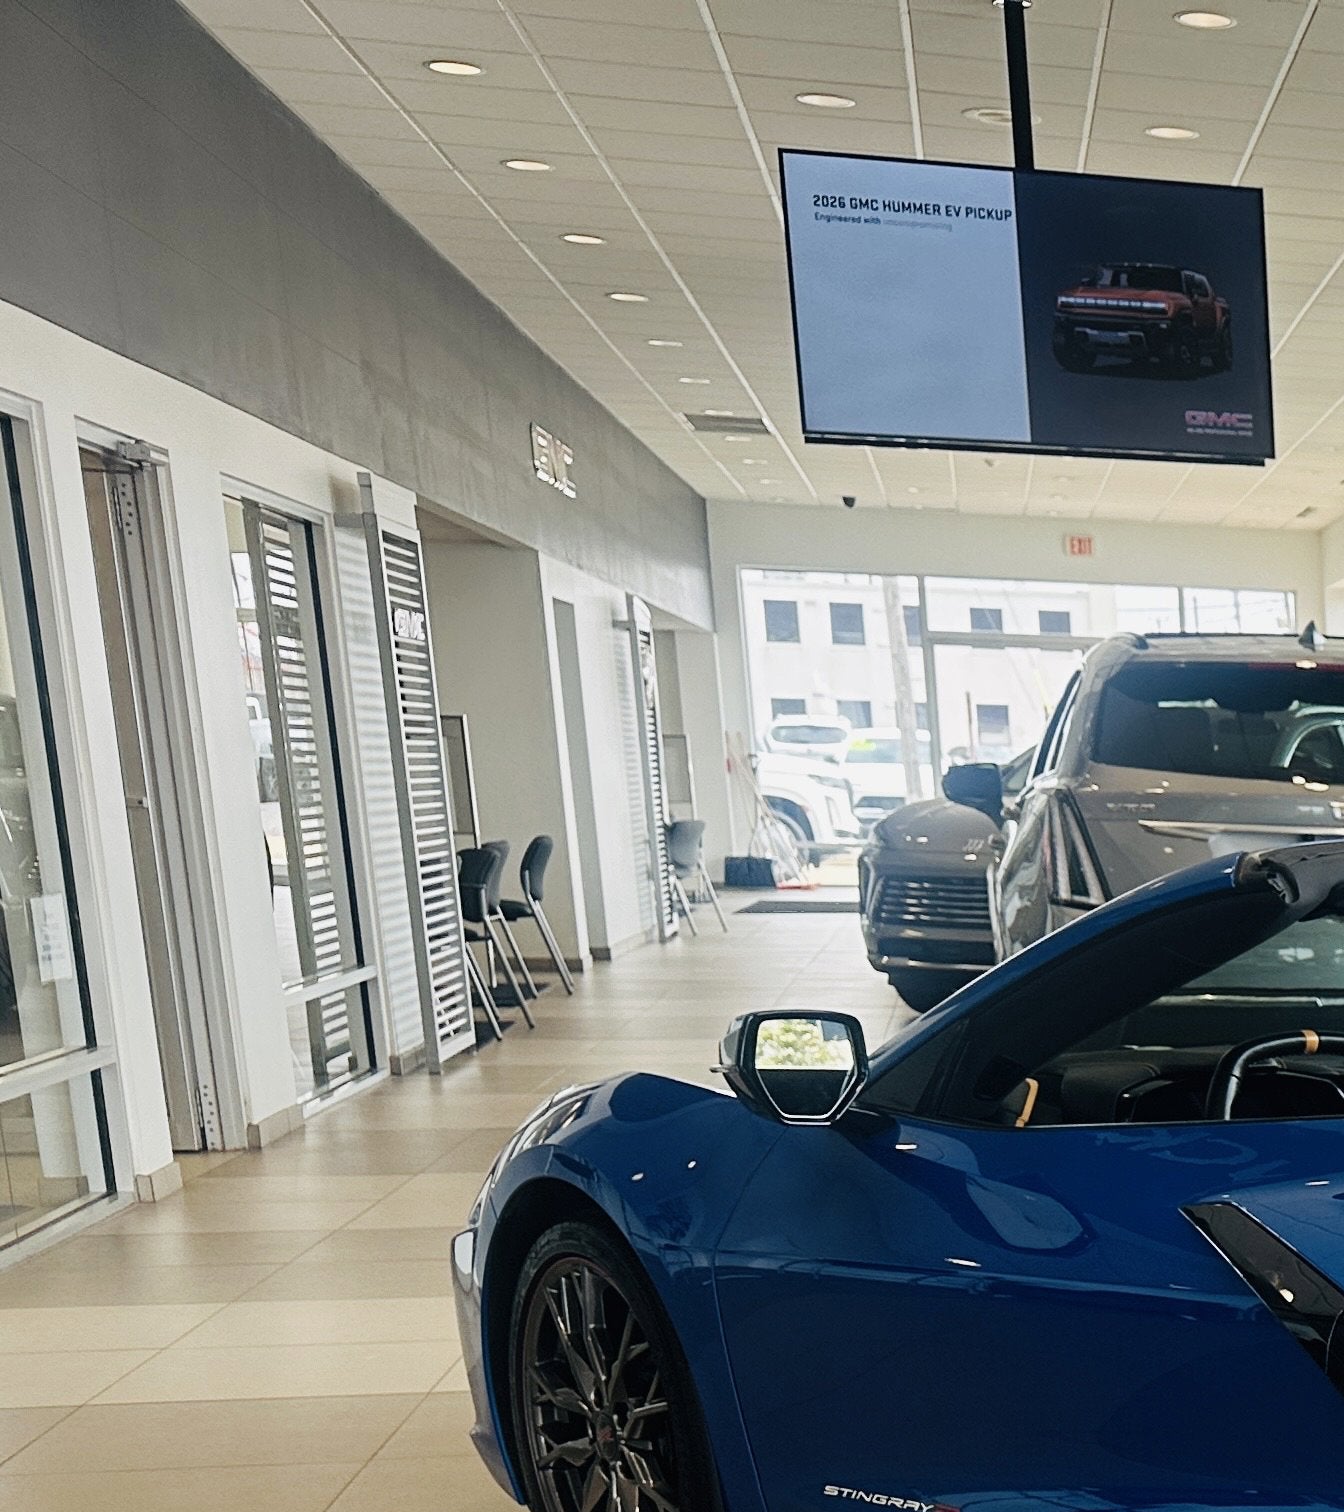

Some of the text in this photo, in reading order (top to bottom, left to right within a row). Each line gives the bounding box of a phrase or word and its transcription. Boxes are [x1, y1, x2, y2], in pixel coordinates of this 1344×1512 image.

[813, 194, 1013, 222] 2026 GMC HUMMER EV PICKUP
[814, 211, 862, 224] Engineered
[823, 1485, 935, 1512] STINGRAY
